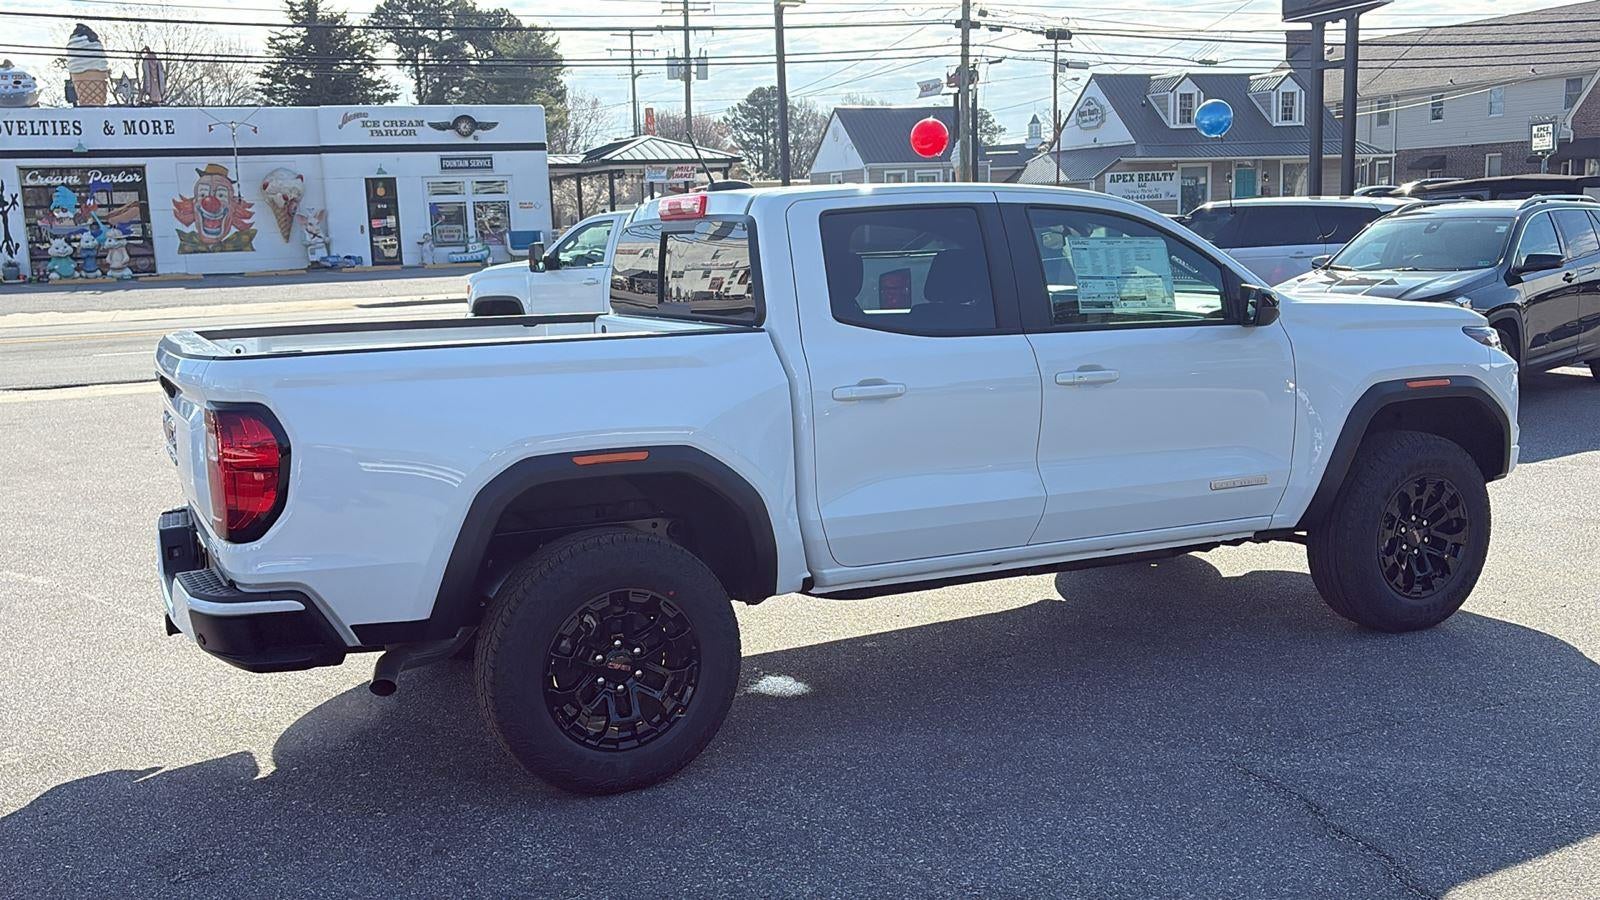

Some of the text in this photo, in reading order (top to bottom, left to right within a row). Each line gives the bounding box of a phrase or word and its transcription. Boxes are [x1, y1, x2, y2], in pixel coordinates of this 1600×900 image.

[0, 120, 176, 136] VELTIES & MORE
[360, 119, 425, 128] ICE CREAM
[369, 128, 418, 137] PARLOR
[442, 159, 492, 168] FOUNTAIN SERVICE
[25, 169, 143, 184] Cream Parlor
[1109, 172, 1175, 184] APEX REALTY
